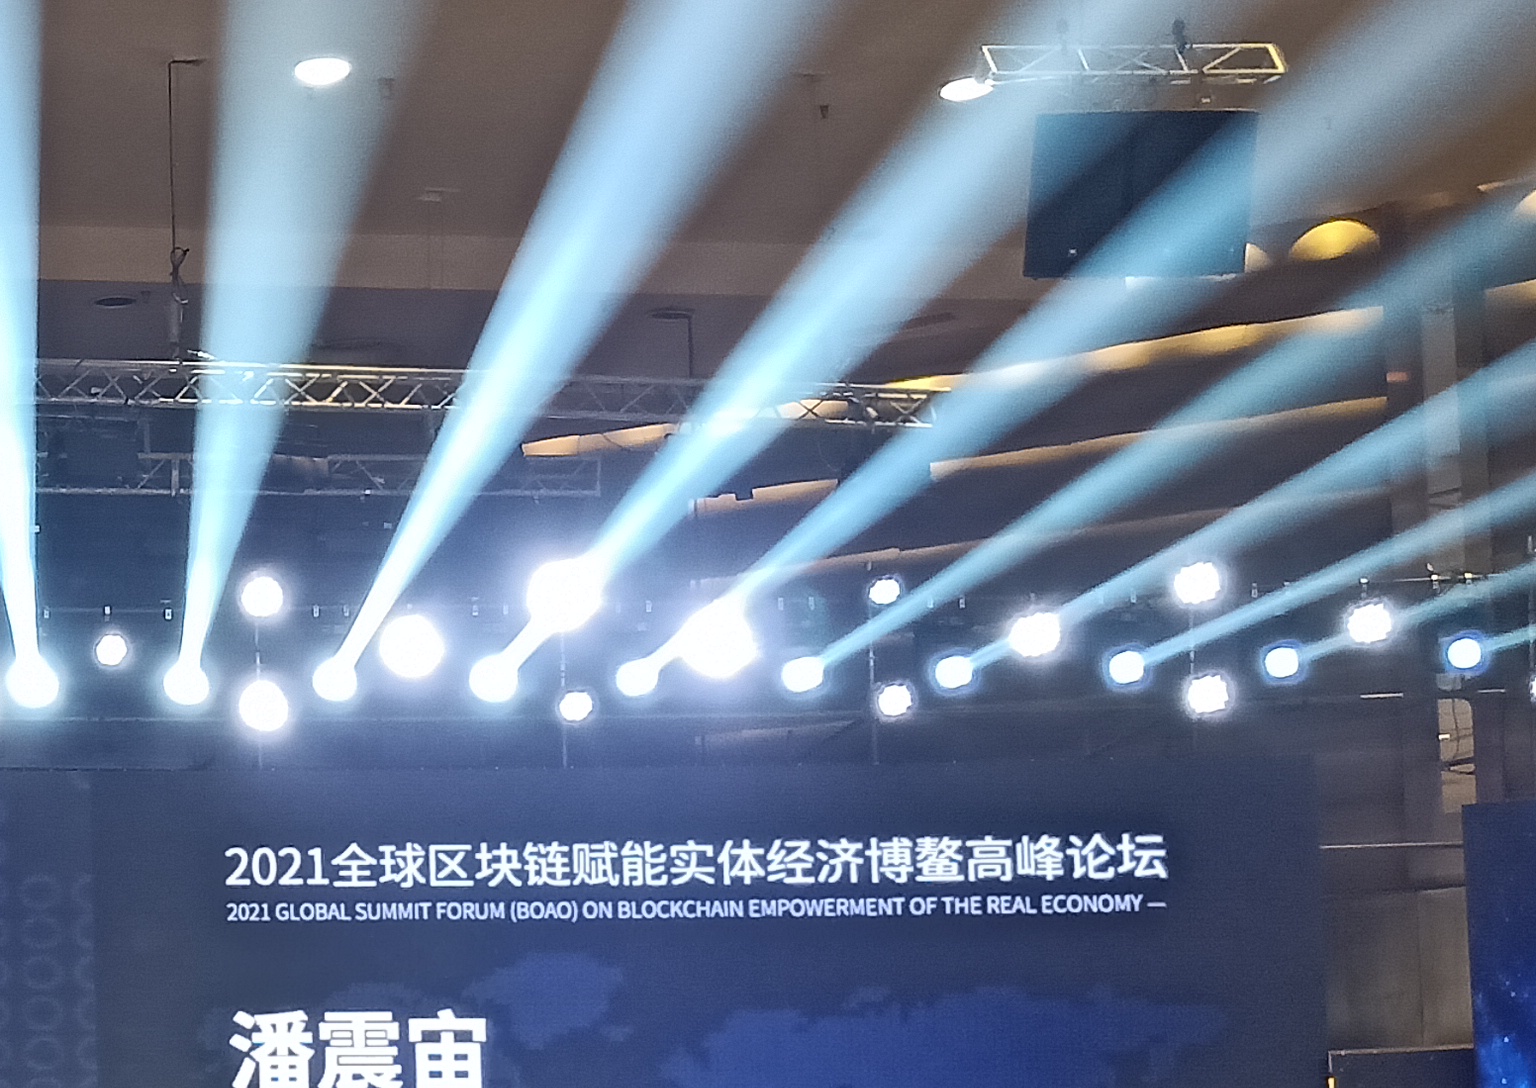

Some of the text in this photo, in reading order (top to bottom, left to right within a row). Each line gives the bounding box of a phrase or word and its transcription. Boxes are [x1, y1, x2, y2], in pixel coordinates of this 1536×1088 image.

[224, 833, 1168, 889] 2021全球区块链赋能实体经济博鳌高峰论坛
[227, 893, 1144, 922] 2021 GLOBAL SUMMIT FORUM (BOAO) ON BLOCKCHAIN EMPOWERMENT OF THE REAL ECONOMY
